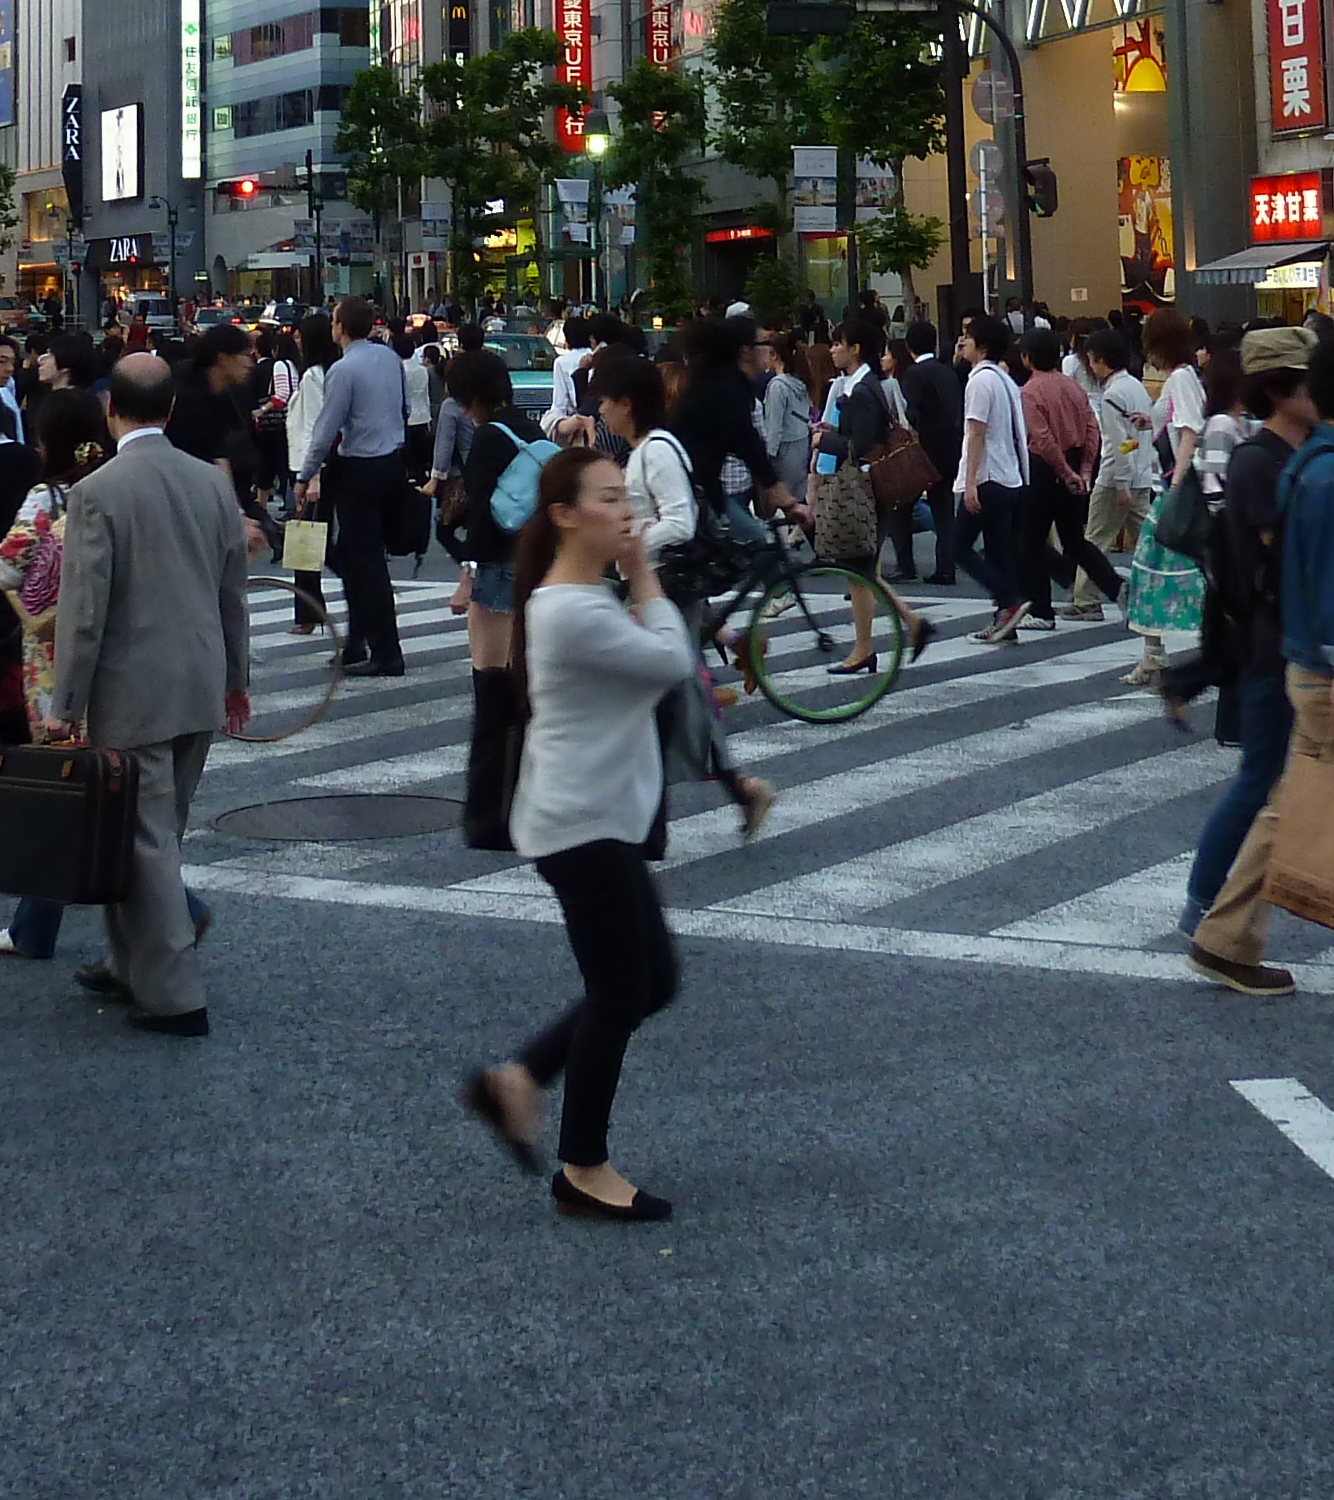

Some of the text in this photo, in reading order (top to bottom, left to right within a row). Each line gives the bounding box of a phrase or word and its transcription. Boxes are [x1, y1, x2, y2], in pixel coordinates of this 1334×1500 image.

[65, 98, 81, 161] ZARA
[1254, 189, 1319, 225] 天津甘栗
[109, 237, 140, 262] ZARA
